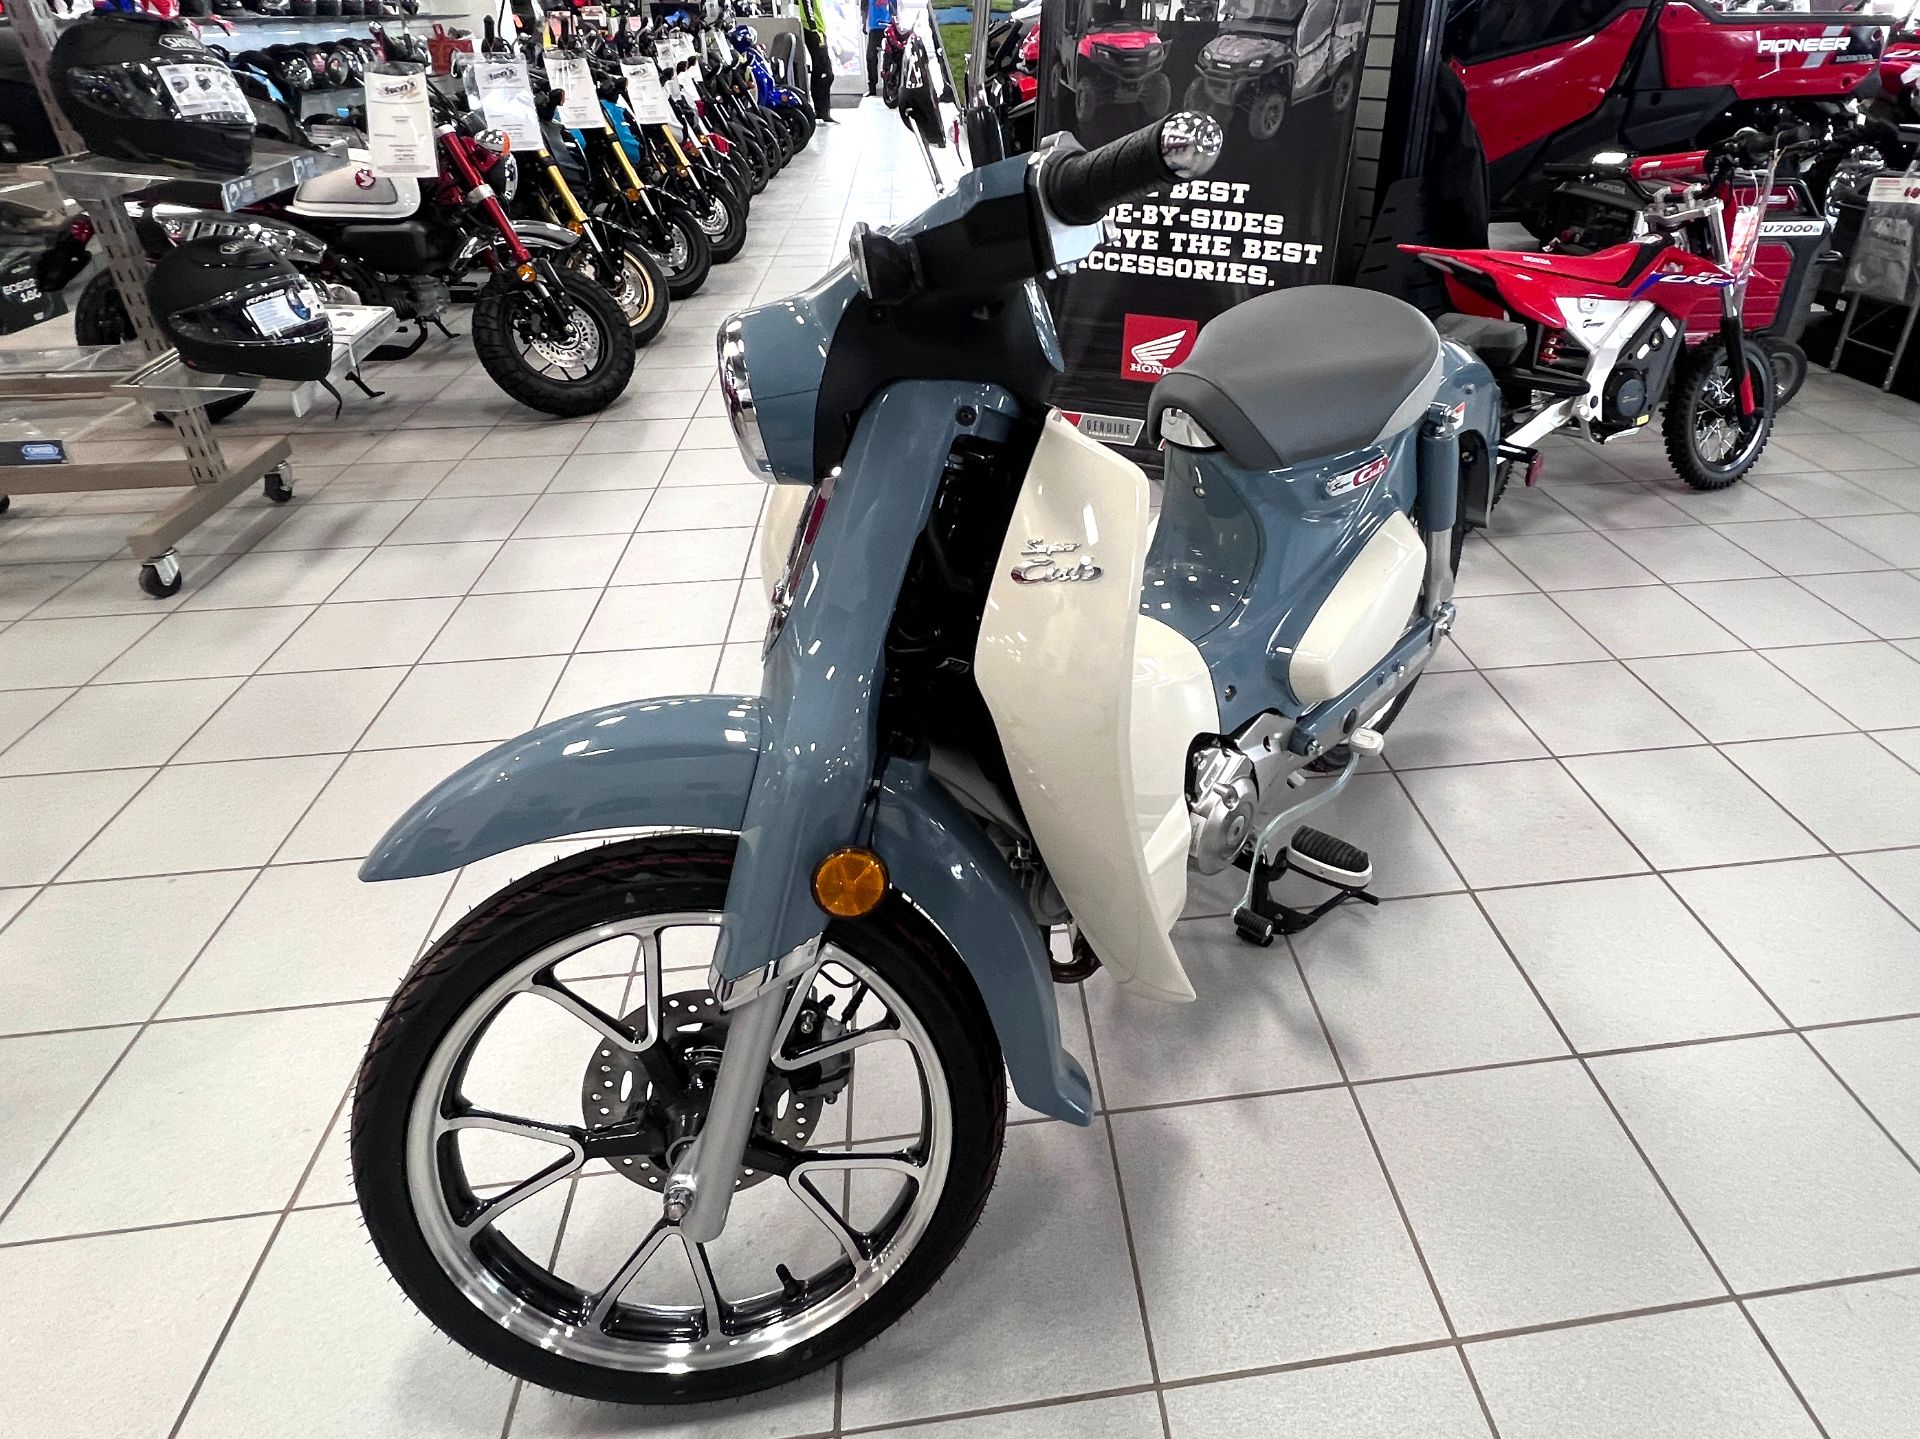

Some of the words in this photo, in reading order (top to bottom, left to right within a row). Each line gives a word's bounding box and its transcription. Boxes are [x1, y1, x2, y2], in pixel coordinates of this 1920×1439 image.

[1758, 37, 1852, 53] PIONEER
[1169, 180, 1250, 204] BEST
[1169, 231, 1232, 257] THE
[1242, 238, 1323, 265] BEST
[1129, 363, 1172, 375] HOND
[1086, 419, 1131, 436] GENUINE
[1010, 555, 1103, 584] Cub
